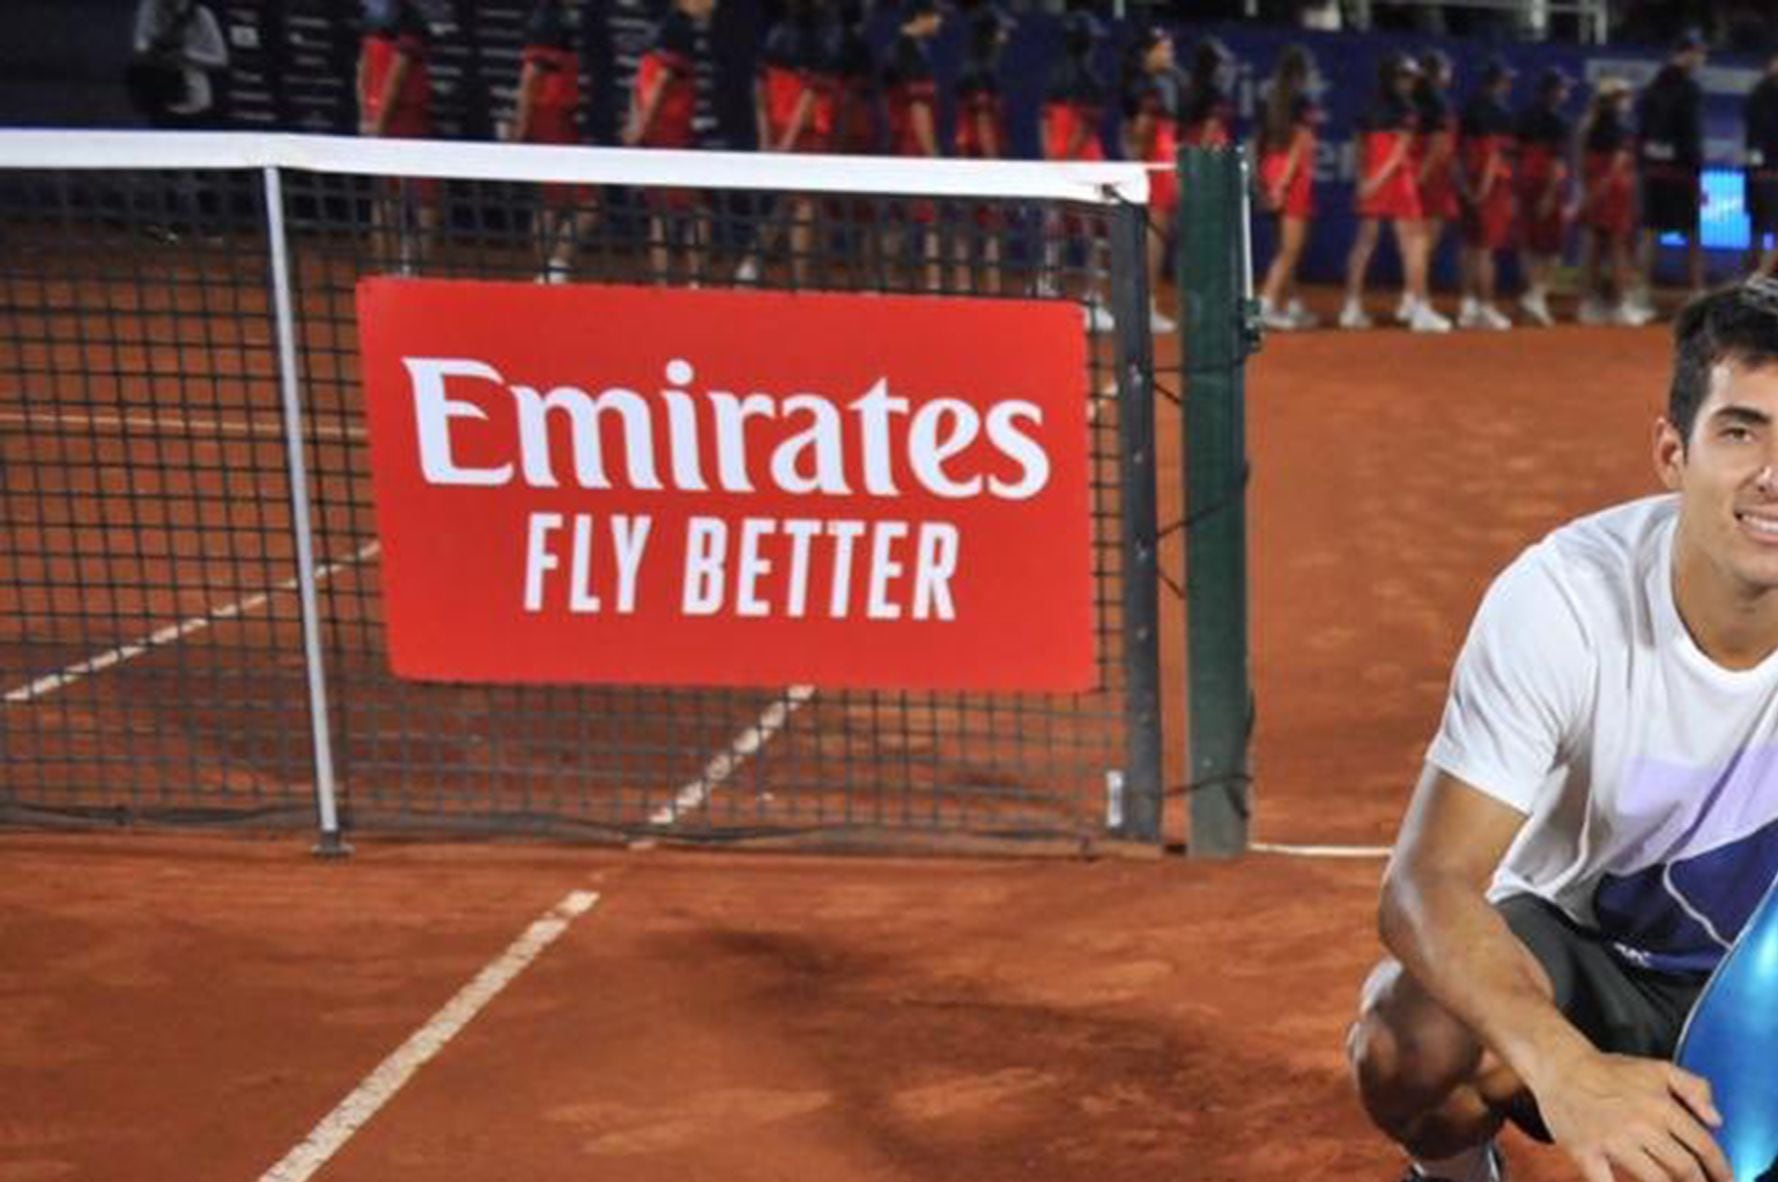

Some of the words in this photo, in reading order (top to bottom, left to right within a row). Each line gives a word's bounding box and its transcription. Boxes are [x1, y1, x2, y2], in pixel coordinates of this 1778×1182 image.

[402, 356, 1051, 500] Emirates
[524, 513, 653, 614] FLY
[681, 515, 960, 622] BETTER
